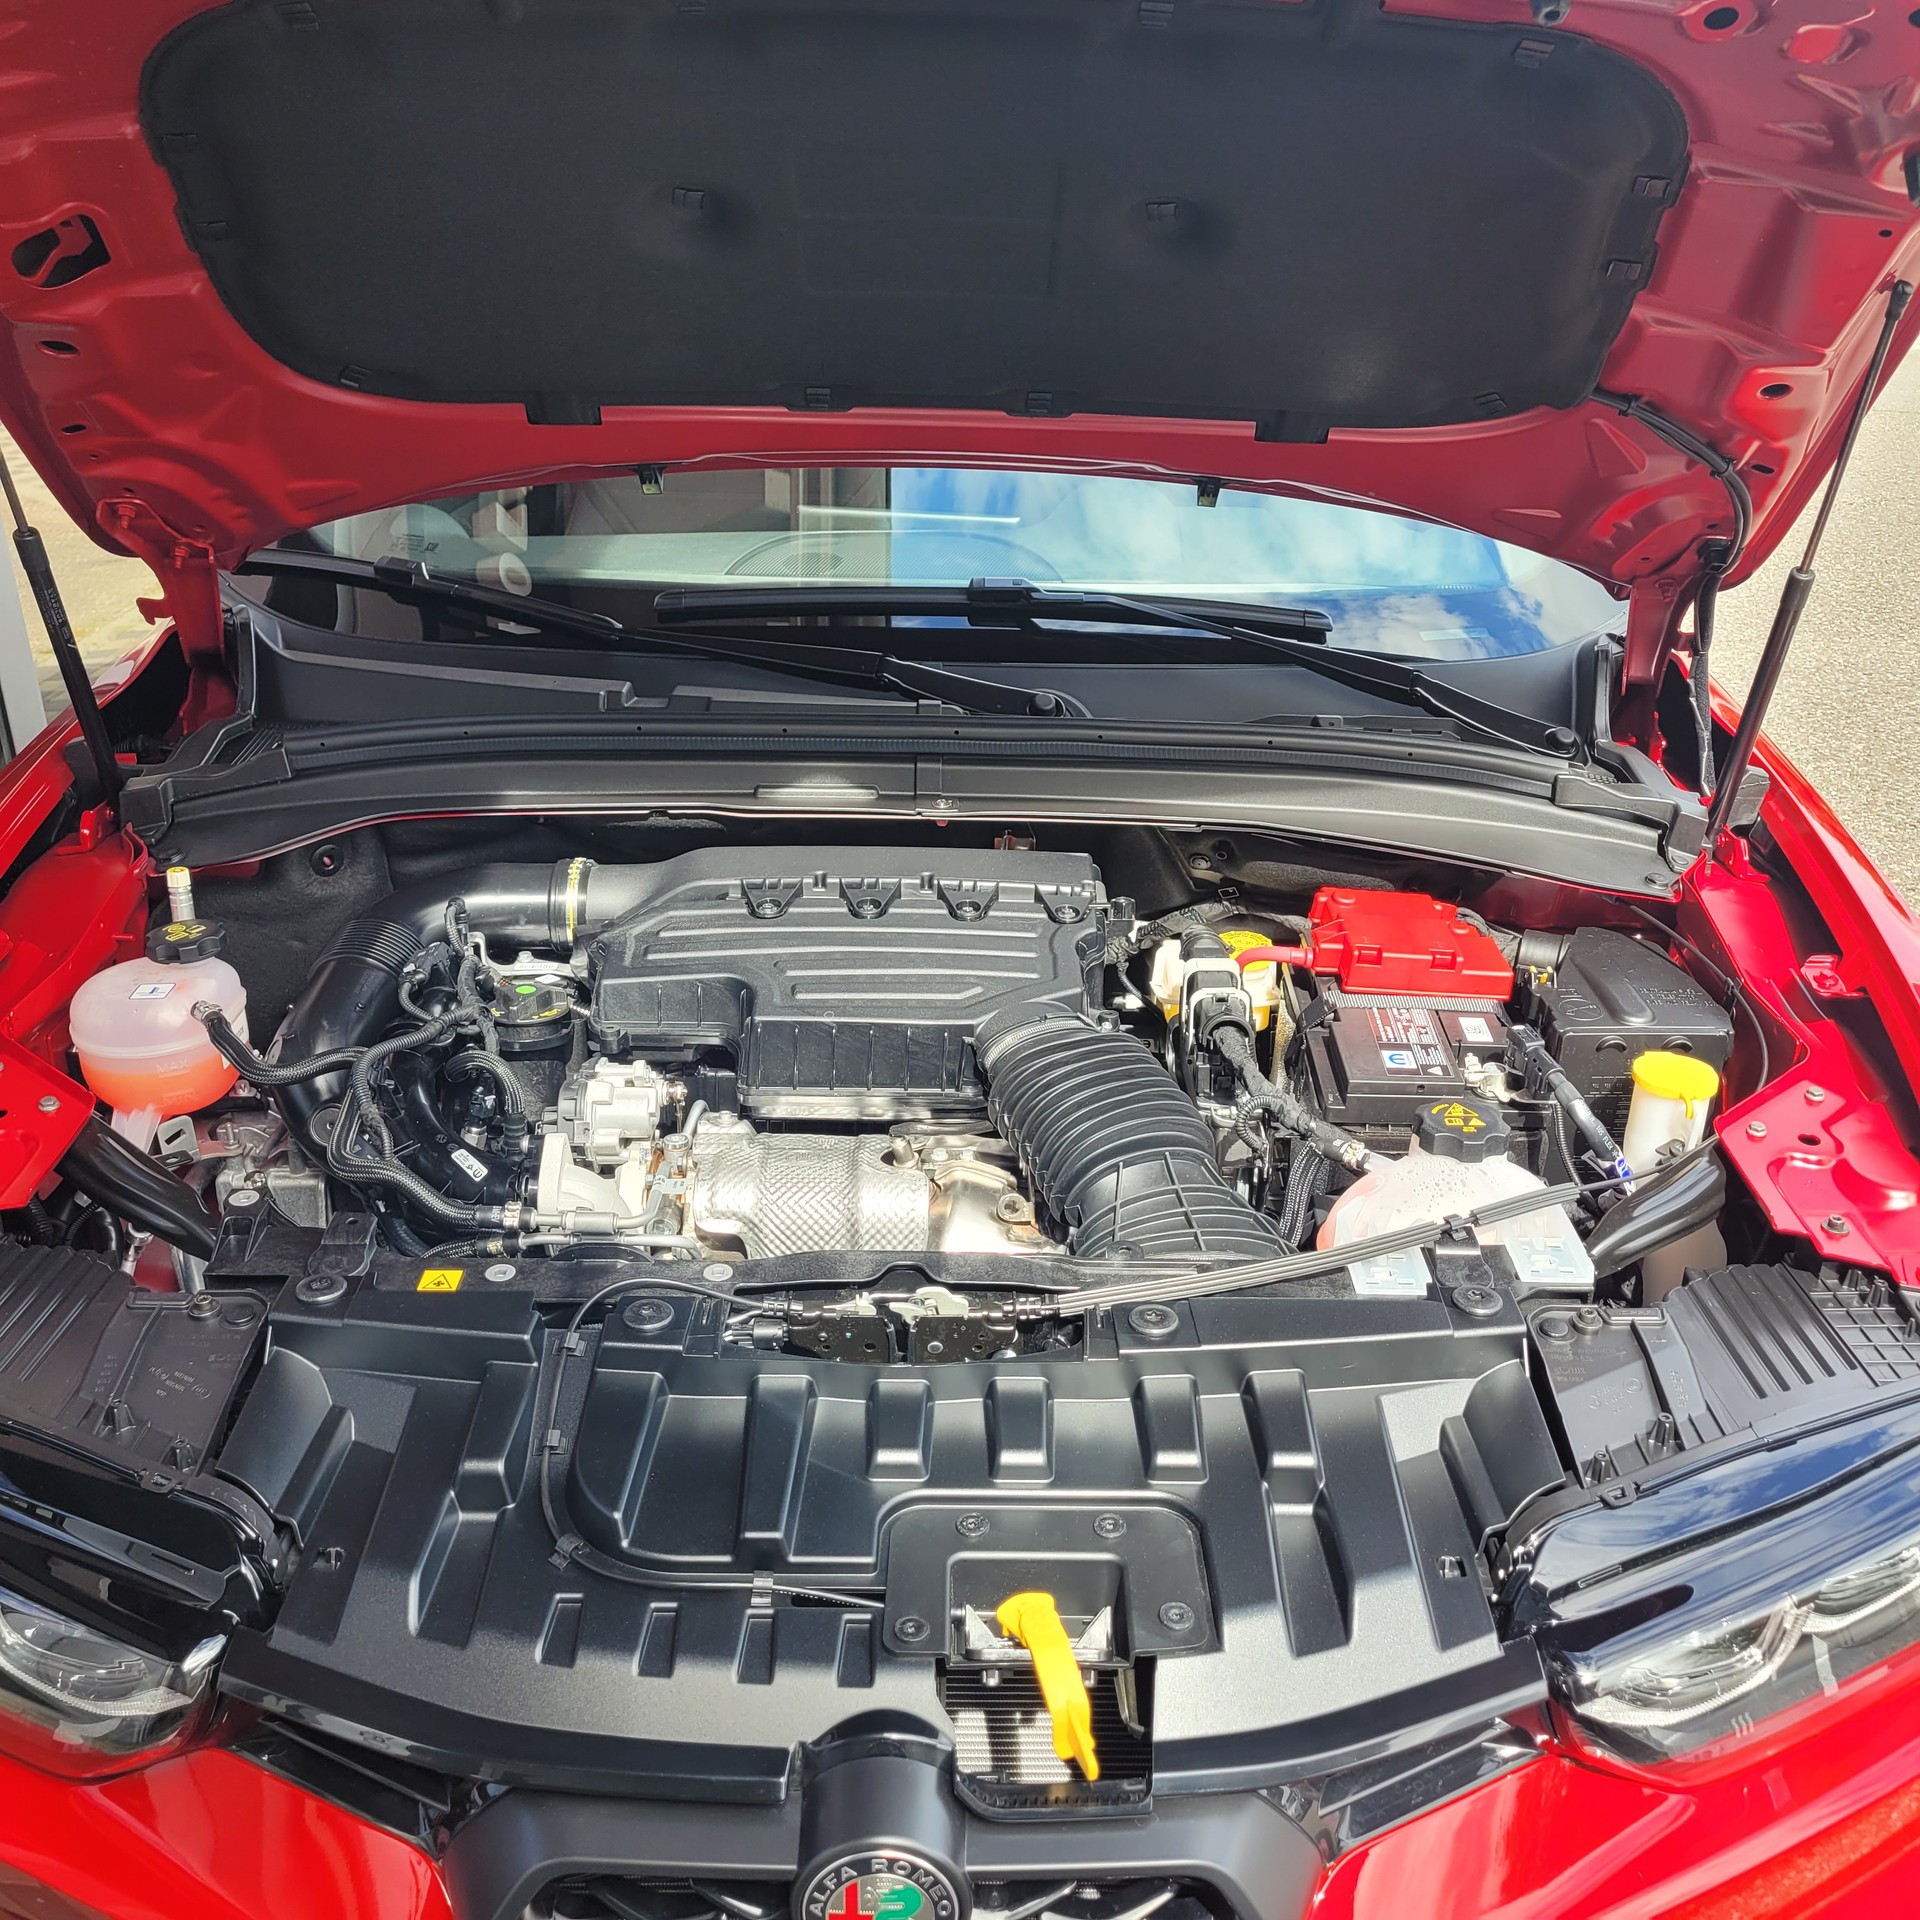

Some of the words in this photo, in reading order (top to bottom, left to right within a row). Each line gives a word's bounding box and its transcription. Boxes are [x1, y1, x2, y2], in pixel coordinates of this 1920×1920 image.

[156, 1060, 190, 1073] MAX
[1602, 1136, 1614, 1151] FLEX
[809, 1865, 858, 1917] ALFA
[871, 1858, 952, 1917] ROMEO
